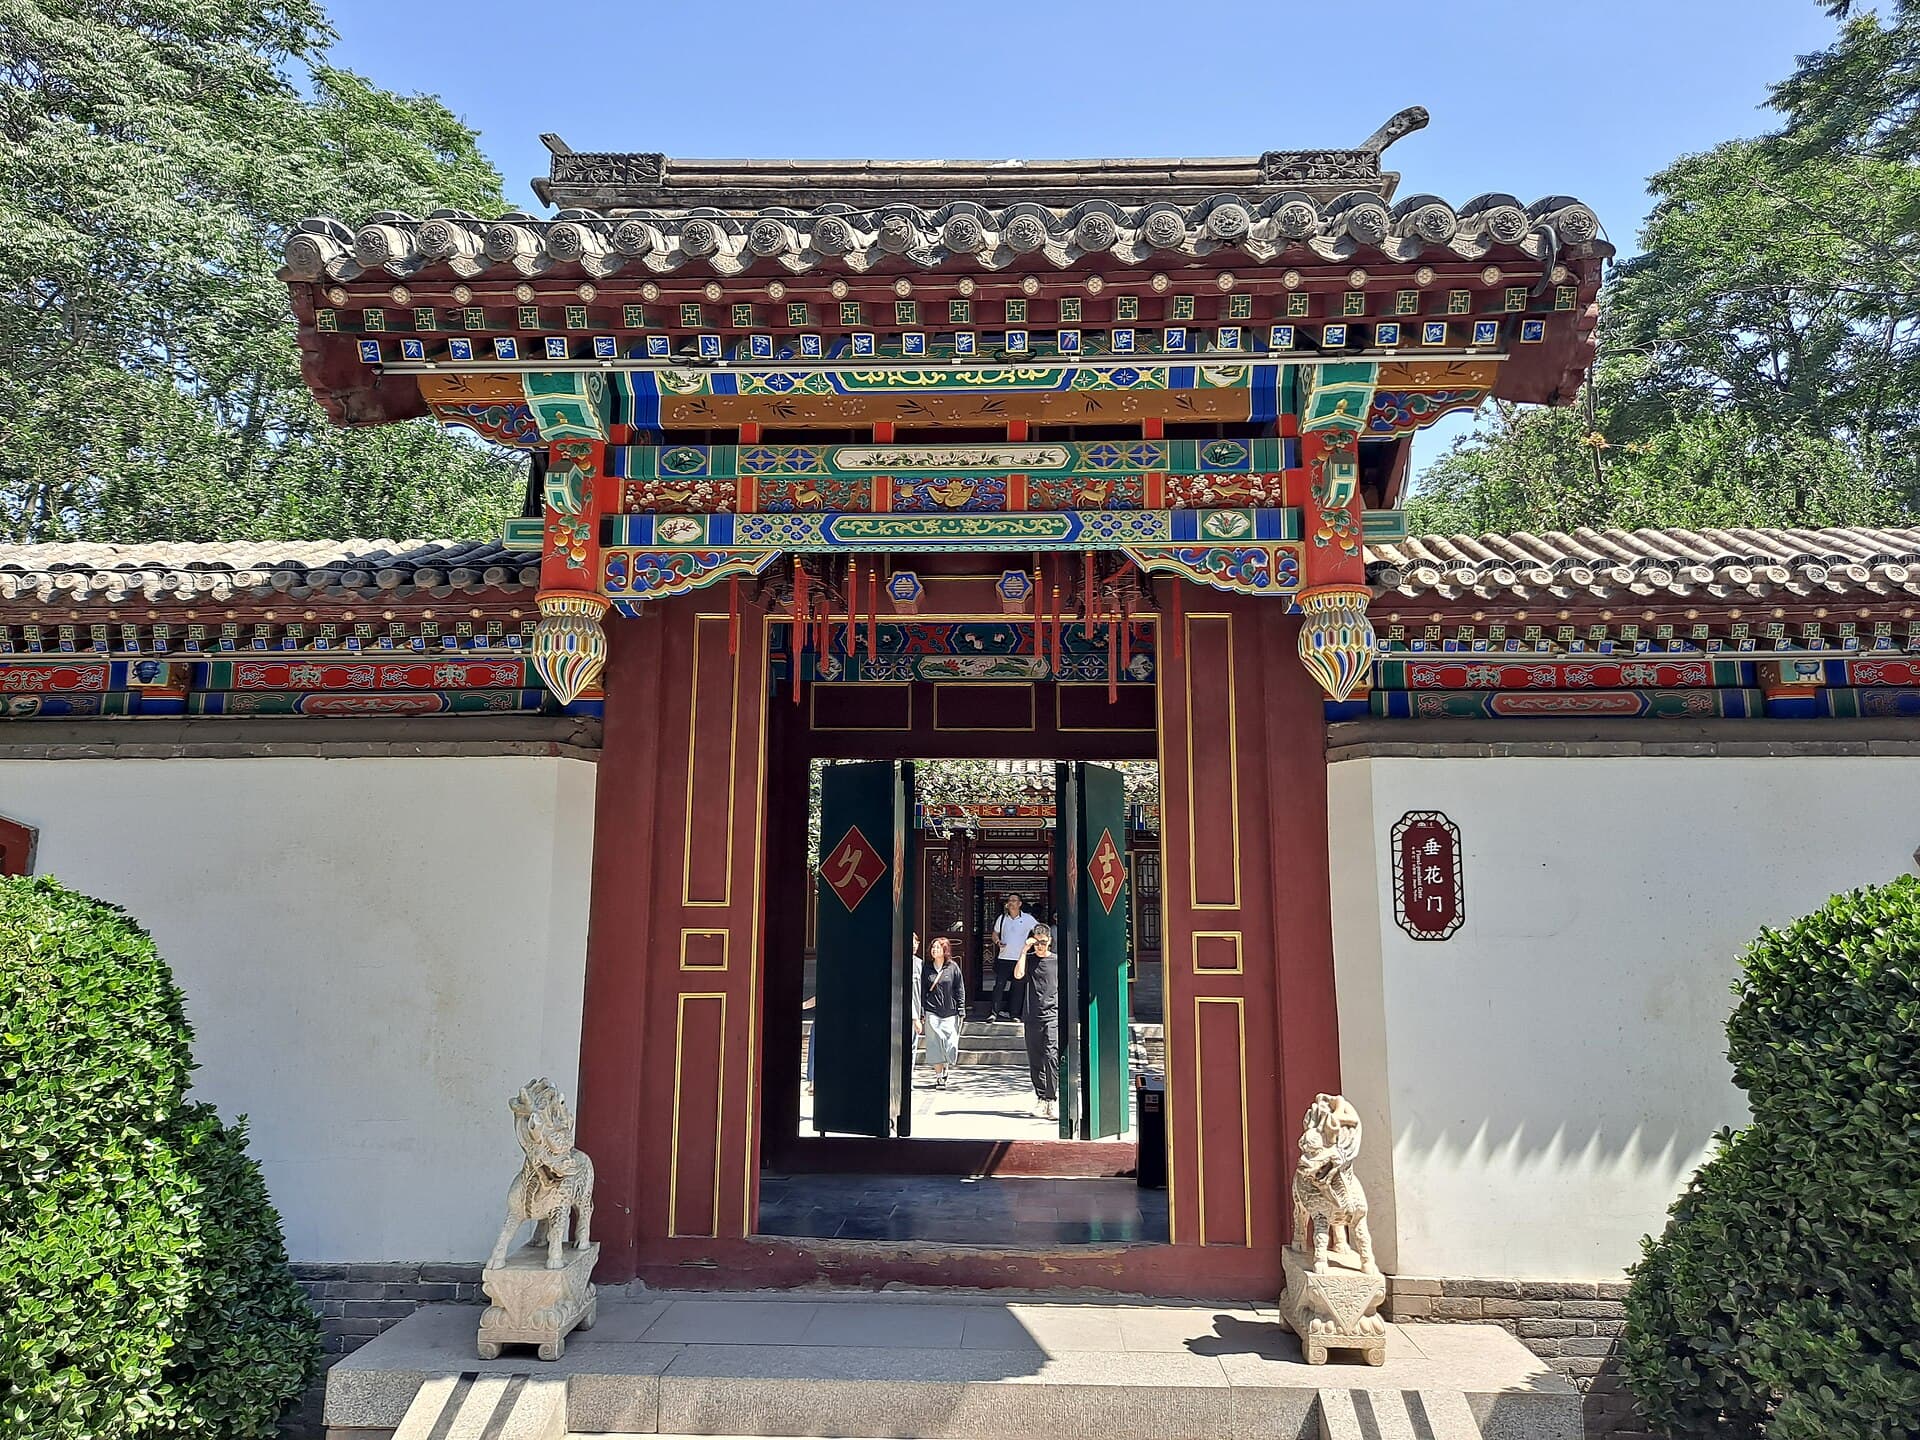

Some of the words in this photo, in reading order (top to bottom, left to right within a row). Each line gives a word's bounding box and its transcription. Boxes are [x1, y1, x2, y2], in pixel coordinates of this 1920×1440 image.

[834, 844, 868, 889] 久
[1422, 837, 1443, 912] 垂花门
